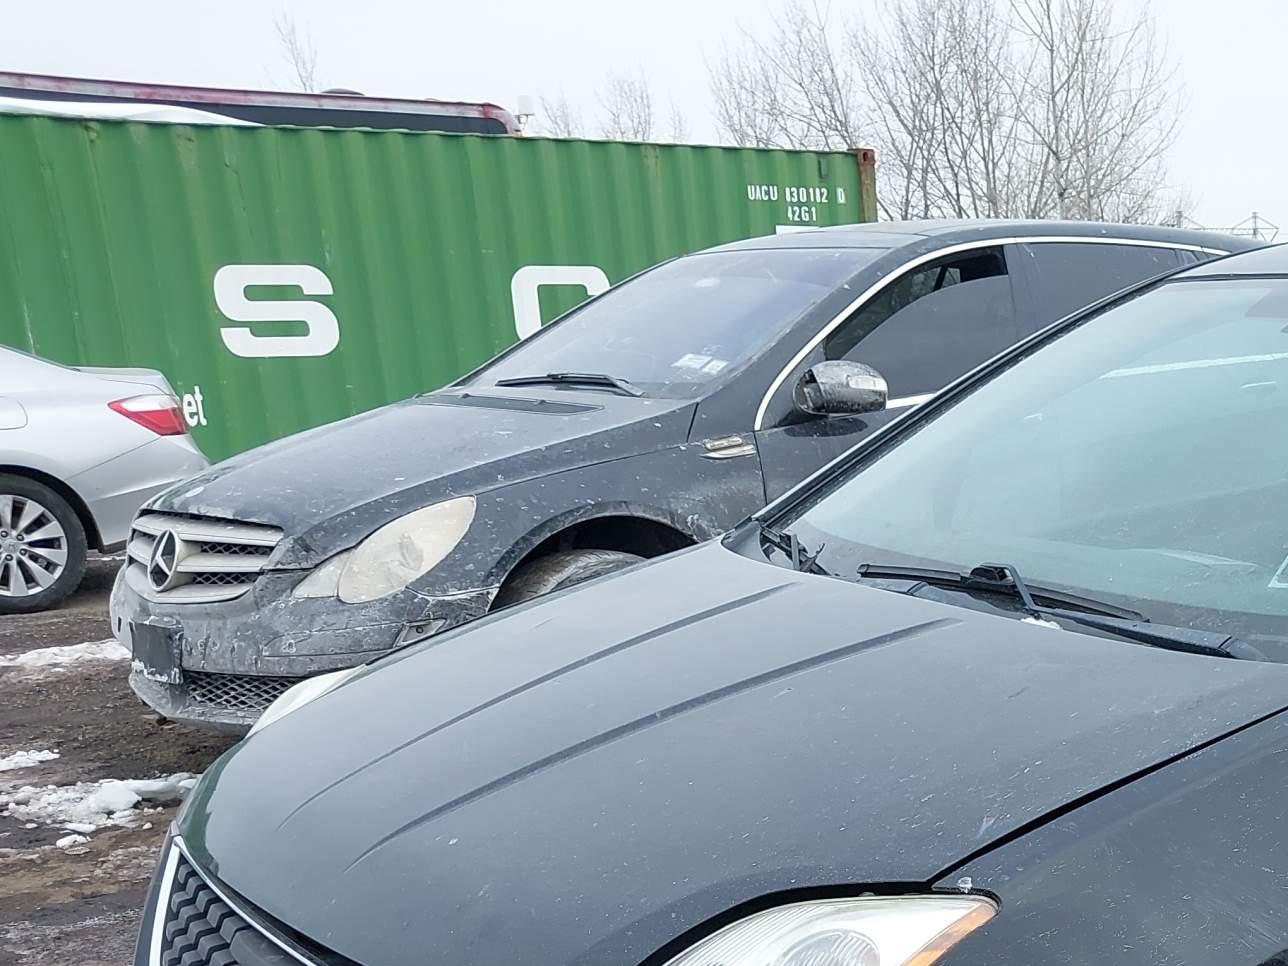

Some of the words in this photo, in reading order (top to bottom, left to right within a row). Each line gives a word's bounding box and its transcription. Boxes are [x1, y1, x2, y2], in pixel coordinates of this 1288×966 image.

[746, 184, 779, 201] UACU
[786, 205, 817, 222] 42G1
[213, 264, 341, 359] S
